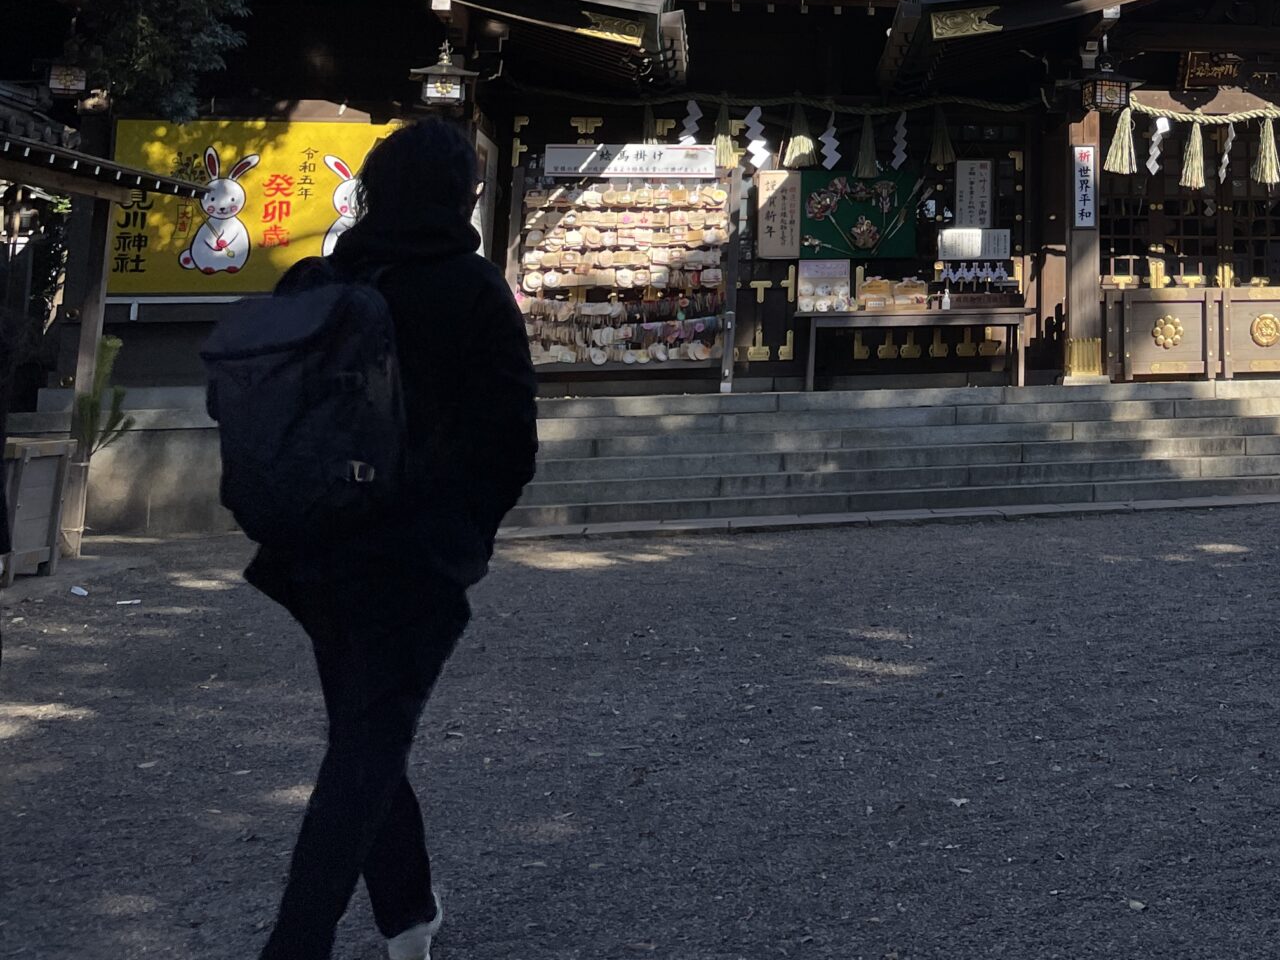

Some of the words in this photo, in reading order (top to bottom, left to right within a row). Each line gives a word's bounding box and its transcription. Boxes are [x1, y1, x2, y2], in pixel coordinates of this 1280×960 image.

[297, 147, 319, 200] 令和五年
[600, 146, 664, 161] 絵馬掛け
[258, 173, 295, 248] 癸卯歳
[1078, 149, 1091, 221] 祈世界平和
[178, 210, 191, 232] 大吉
